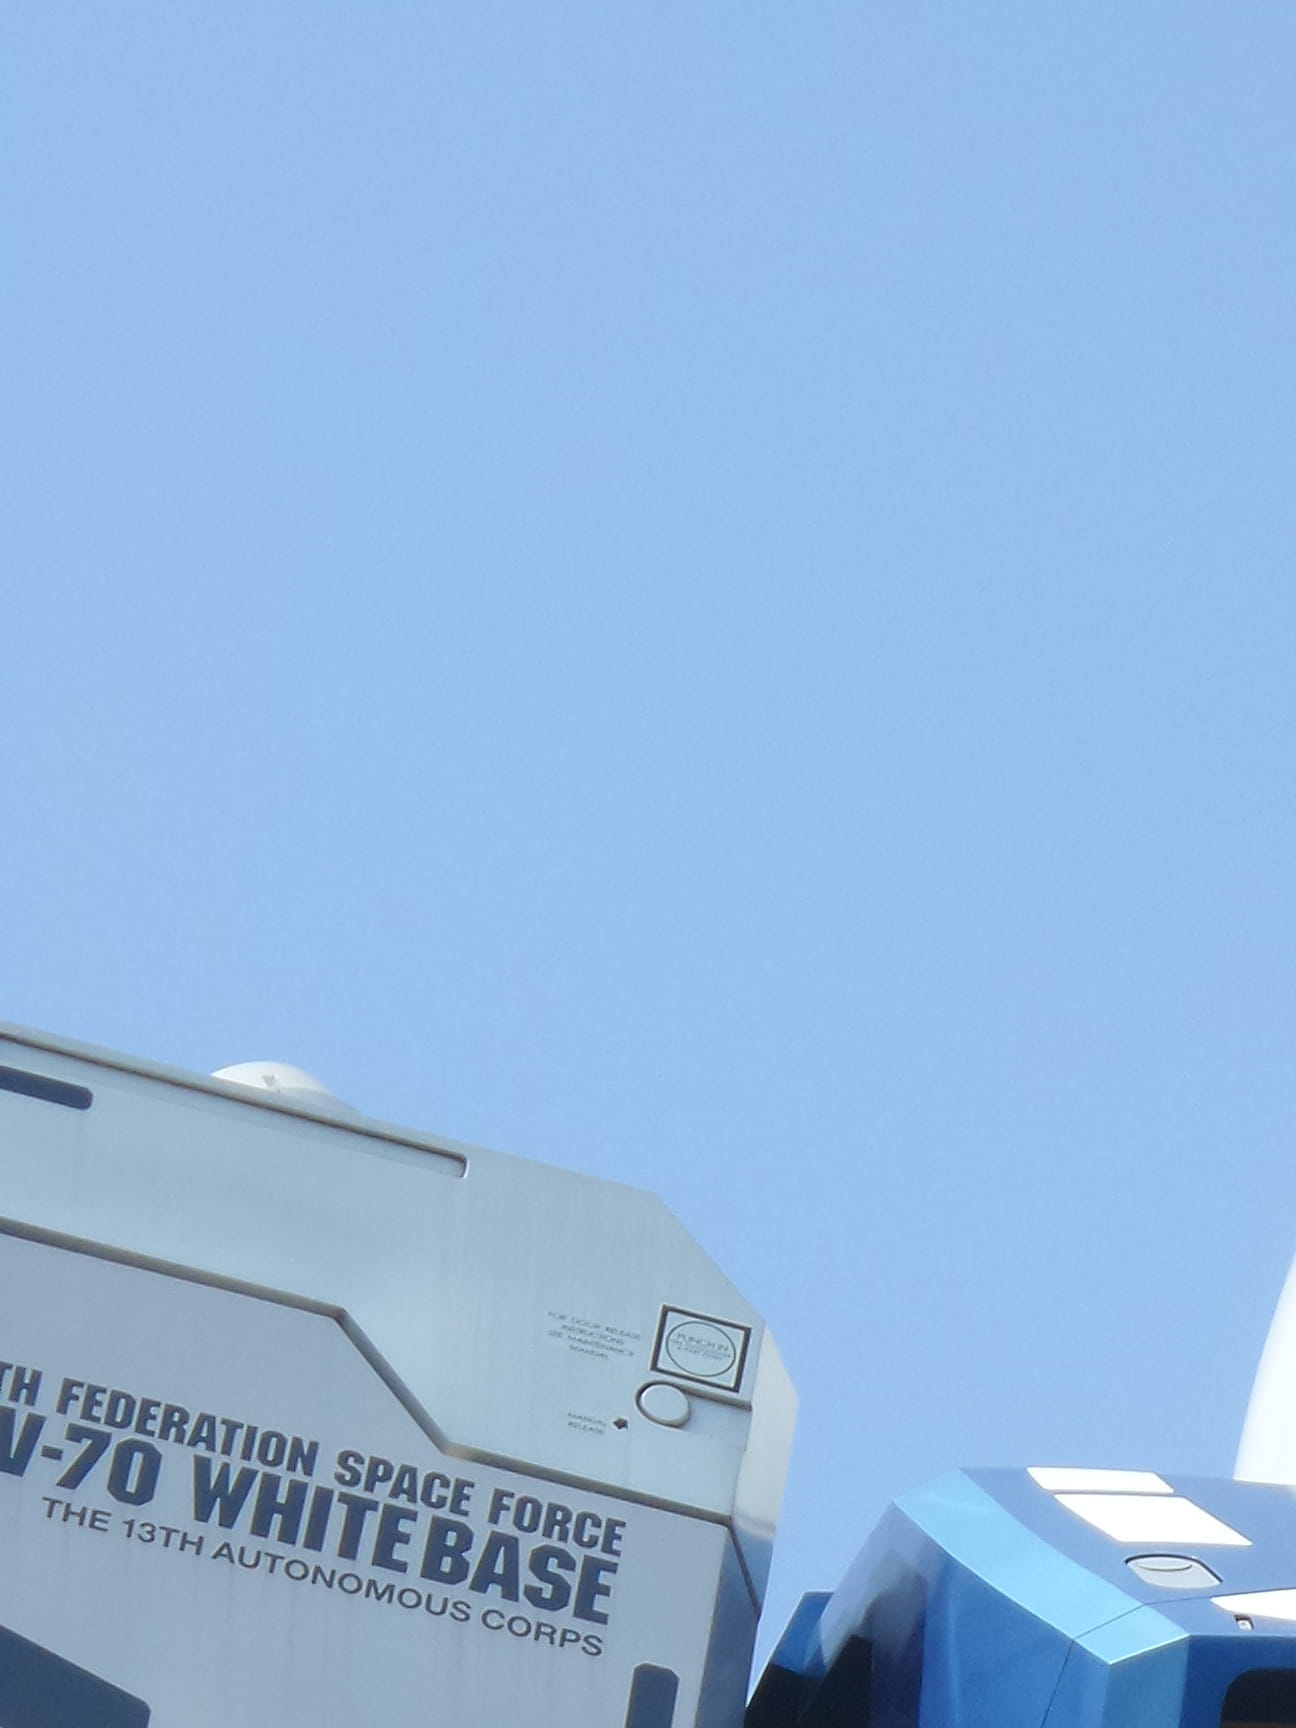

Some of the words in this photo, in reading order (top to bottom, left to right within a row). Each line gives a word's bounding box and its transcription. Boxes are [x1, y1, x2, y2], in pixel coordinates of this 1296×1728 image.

[56, 1377, 320, 1477] FEDERATION
[333, 1449, 475, 1517] SPACE
[487, 1487, 627, 1557] FORCE
[42, 1496, 112, 1532] THE
[122, 1517, 204, 1556] 13TH
[211, 1541, 471, 1623] AUTONOMOUS
[481, 1608, 604, 1657] CORPS
[419, 1513, 619, 1626] BASE
